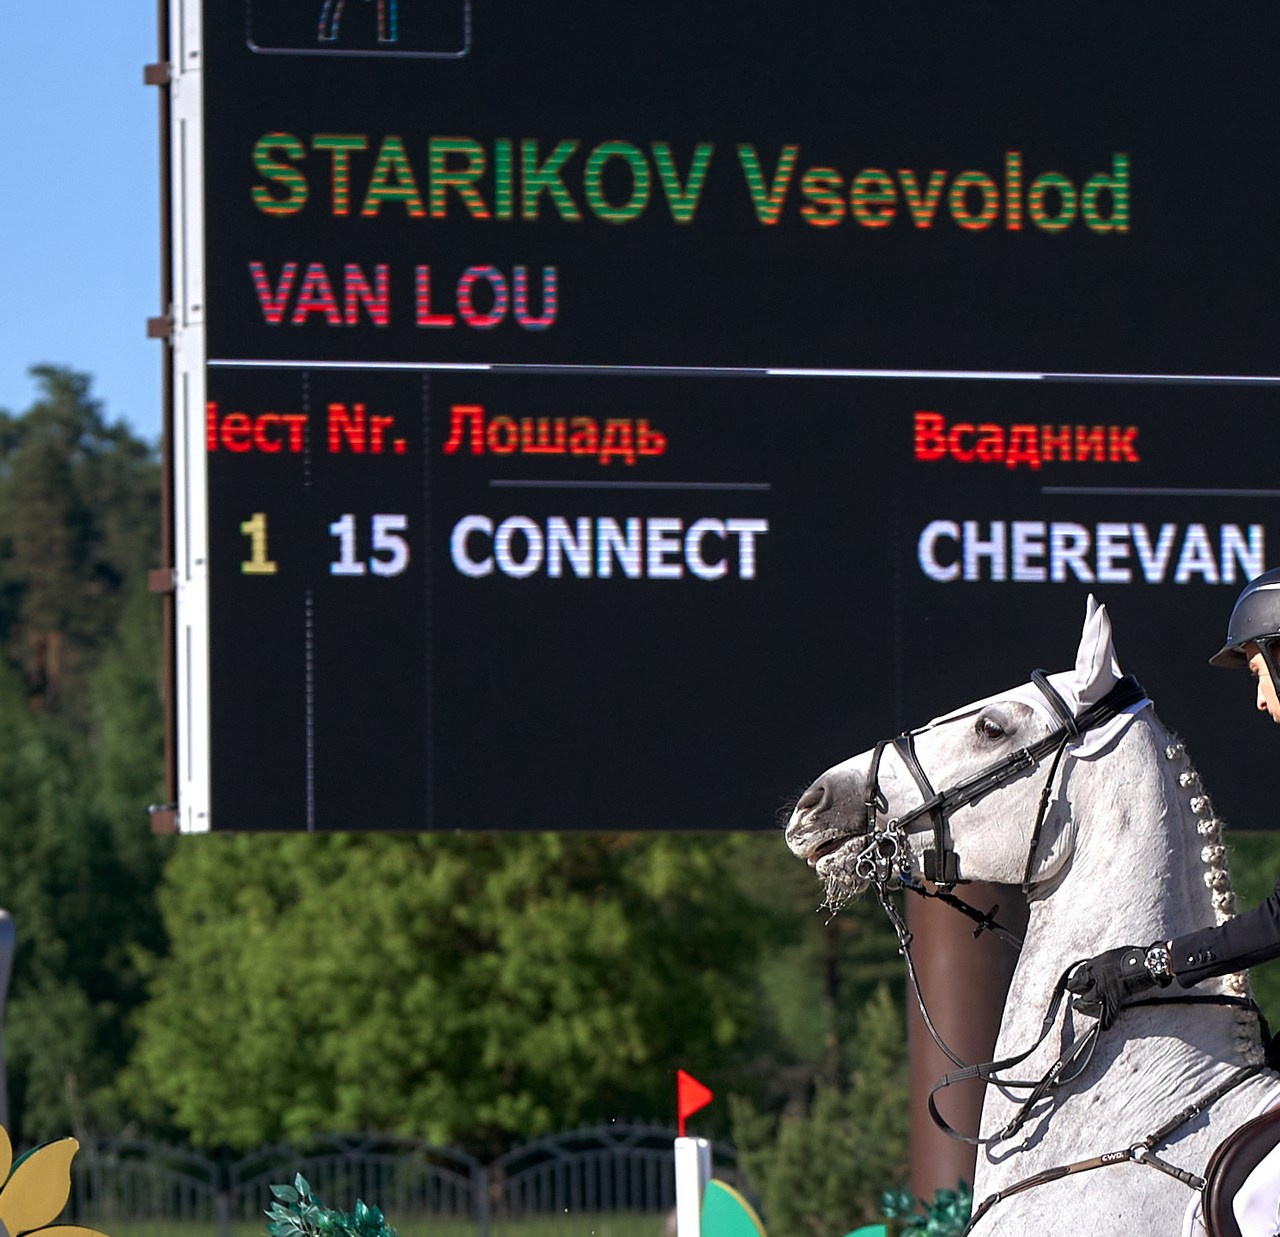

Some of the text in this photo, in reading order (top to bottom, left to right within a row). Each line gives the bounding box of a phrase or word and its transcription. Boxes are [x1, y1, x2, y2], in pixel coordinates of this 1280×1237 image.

[251, 132, 1129, 233] STARIKOV Vsevolod
[249, 261, 558, 330] VAN LOU
[328, 402, 407, 453] Nr.
[443, 405, 668, 468] Лошадь
[914, 411, 1141, 470] Всадник
[240, 512, 278, 575] 1
[328, 513, 411, 578] 15
[449, 514, 770, 582] CONNECT
[917, 518, 1266, 585] CHEREVAN
